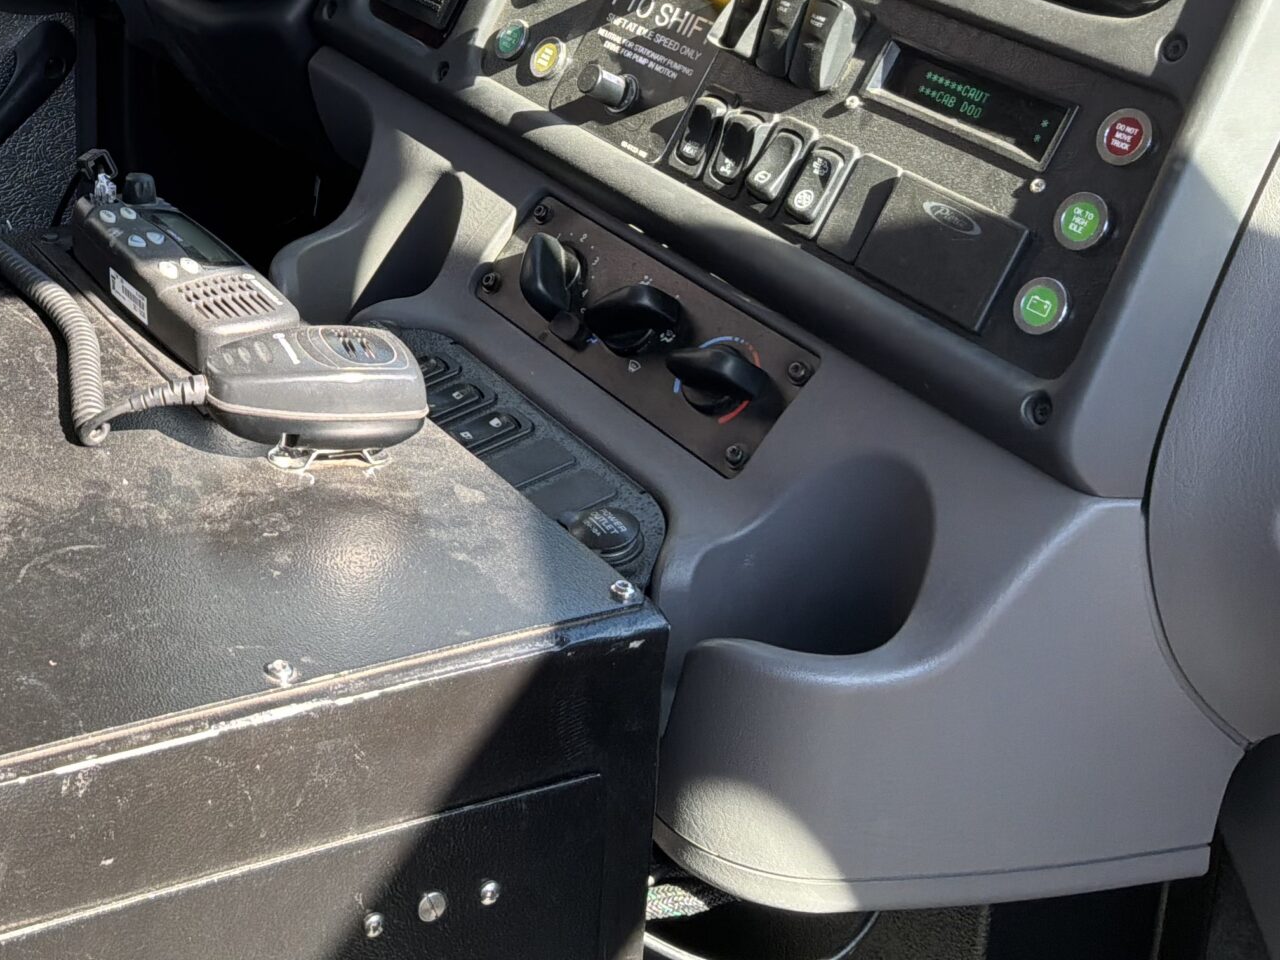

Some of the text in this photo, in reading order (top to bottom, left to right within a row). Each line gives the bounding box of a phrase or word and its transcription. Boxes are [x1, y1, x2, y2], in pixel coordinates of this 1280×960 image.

[606, 12, 628, 29] SHIFT
[625, 20, 638, 33] AT
[653, 33, 681, 52] SPEED
[679, 45, 703, 61] ONLY
[621, 38, 635, 49] FOR
[634, 43, 667, 64] STATIONARY
[665, 58, 694, 77] PUMPING
[632, 53, 650, 66] PUMP
[647, 61, 655, 69] IN
[654, 63, 679, 80] MOTION
[959, 101, 983, 119] DOO
[1115, 122, 1140, 136] DO NOT
[1114, 130, 1134, 143] MOVE
[1110, 138, 1132, 151] TRUCK
[1073, 206, 1095, 221] OK TO
[1068, 222, 1085, 235] IDLE
[1072, 215, 1089, 228] HIGH
[579, 233, 588, 243] 2
[591, 256, 600, 266] 3
[590, 511, 620, 535] OUTLET
[600, 508, 628, 532] POWER
